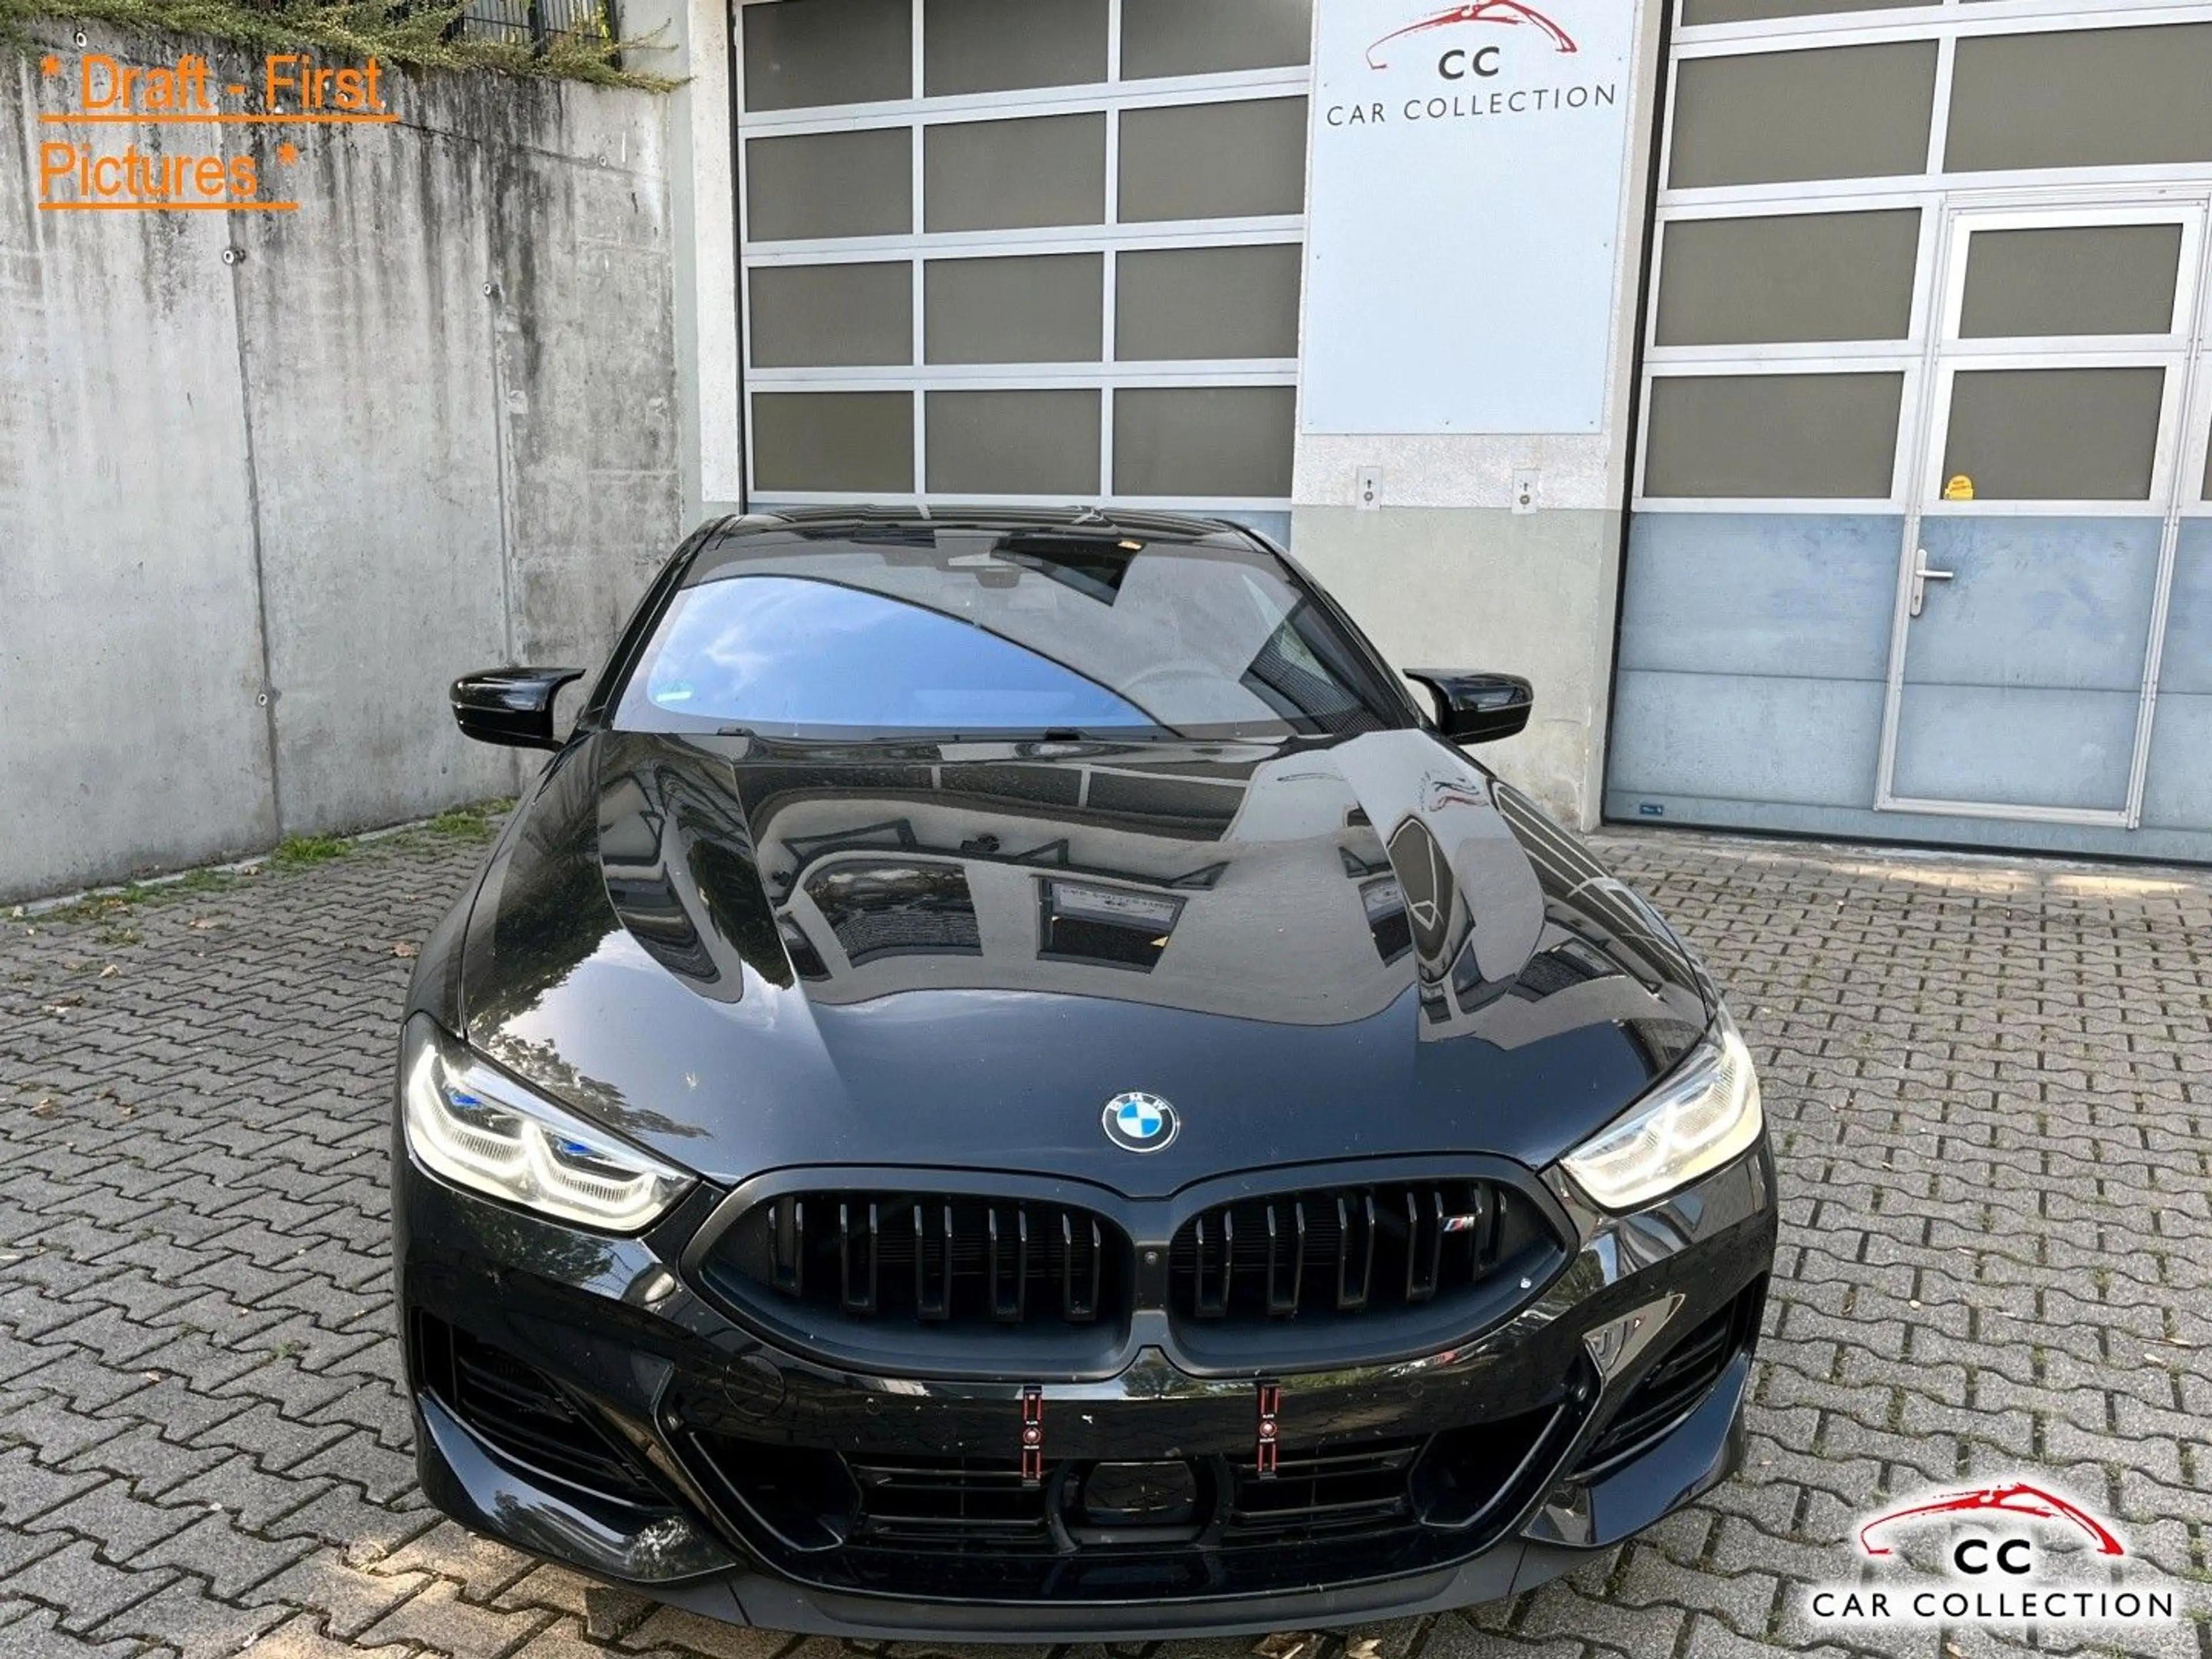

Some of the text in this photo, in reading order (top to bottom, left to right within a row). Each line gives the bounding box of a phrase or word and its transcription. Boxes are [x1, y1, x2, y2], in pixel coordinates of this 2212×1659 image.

[1438, 46, 1500, 80] CC
[1327, 84, 1615, 126] CAR COLLECTION
